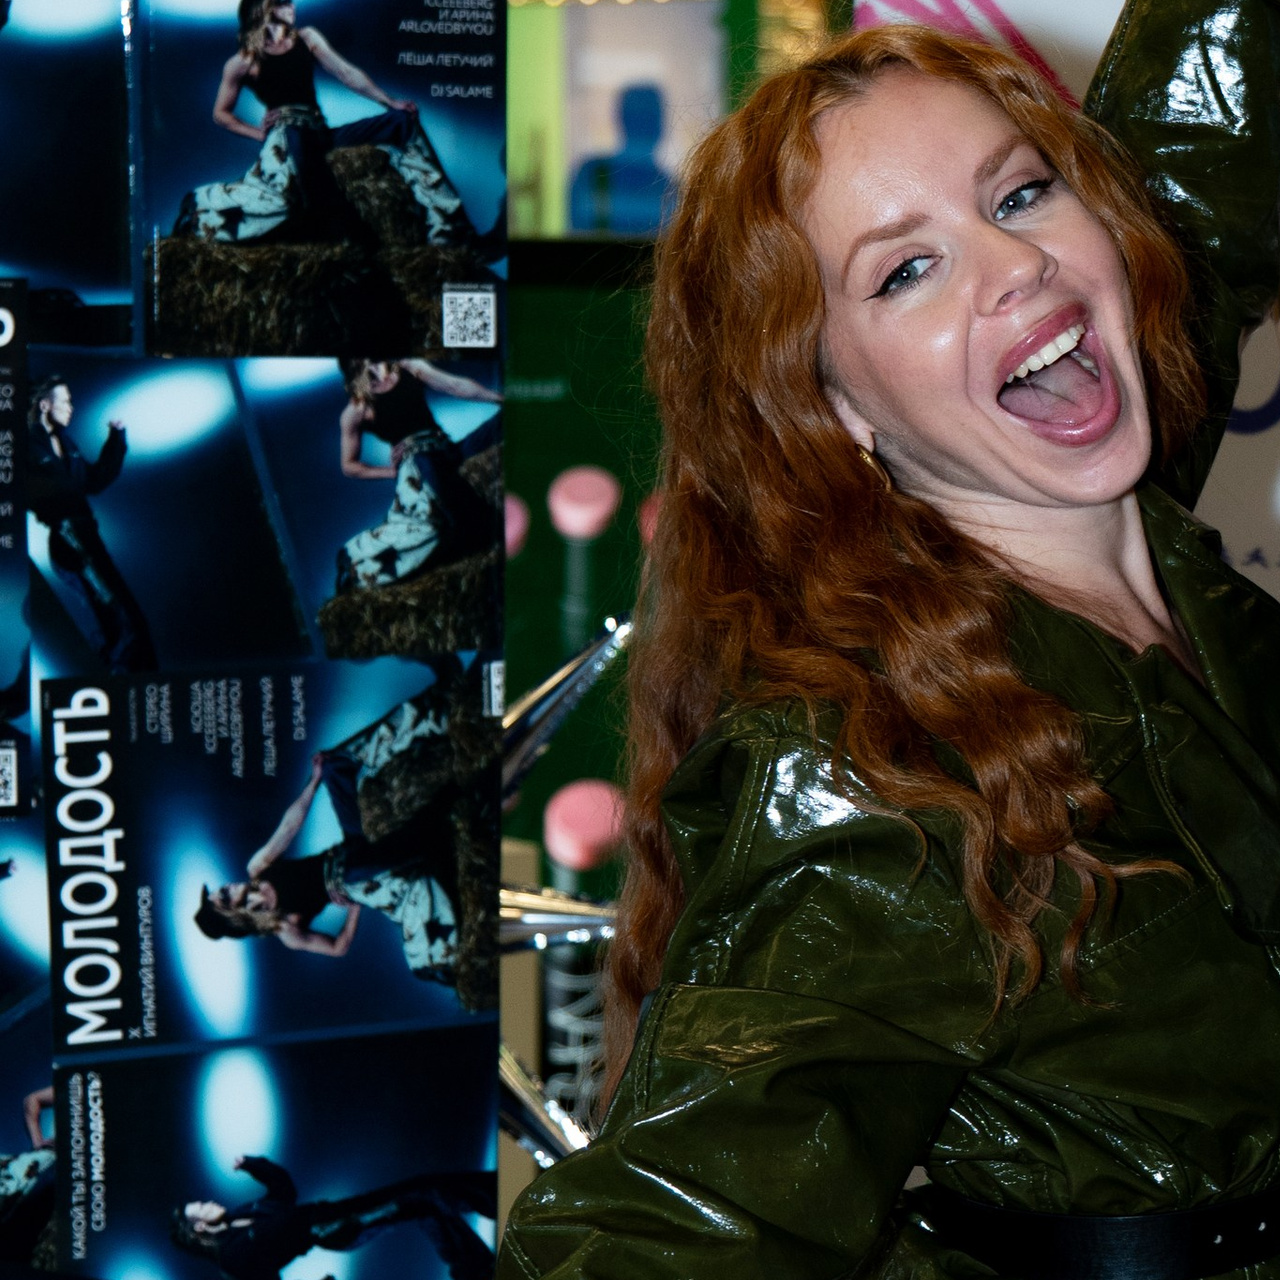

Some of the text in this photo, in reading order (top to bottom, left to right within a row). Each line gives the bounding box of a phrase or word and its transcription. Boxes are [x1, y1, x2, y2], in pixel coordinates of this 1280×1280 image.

[399, 20, 494, 36] ARLOVEDBYYOU
[439, 10, 493, 21] И АРИНА
[436, 53, 494, 67] ЛЕТУЧИЙ
[430, 83, 493, 98] DJ SALAME
[145, 683, 159, 733] СТЕРЕО
[52, 687, 125, 1045] МОЛОДОСТЬ
[137, 885, 157, 1037] ИГНАТИЙ ВИНТУРОВ
[69, 1072, 87, 1259] КАКОЙ ТЫ ЗАПОМНИШЬ
[87, 1071, 106, 1232] СВОЮ МОЛОДОСТЬ?
